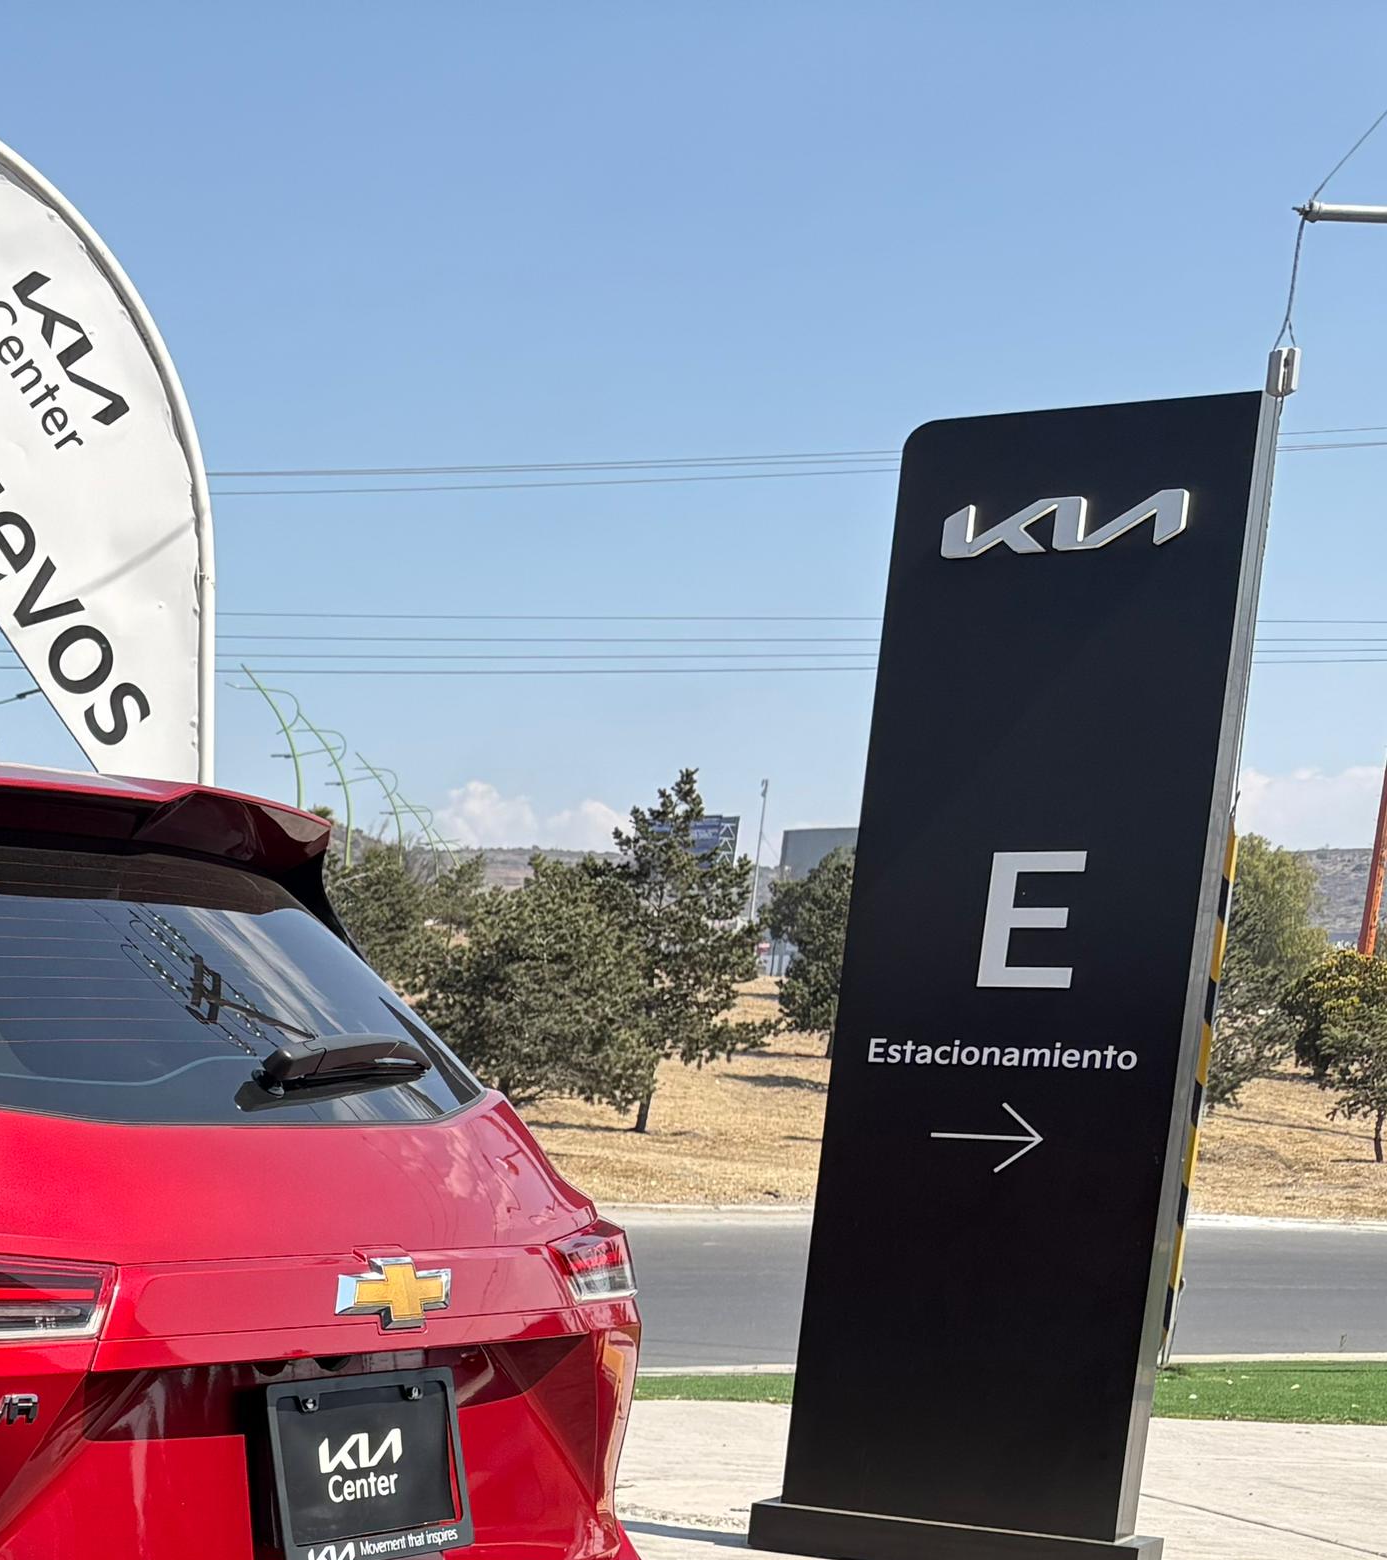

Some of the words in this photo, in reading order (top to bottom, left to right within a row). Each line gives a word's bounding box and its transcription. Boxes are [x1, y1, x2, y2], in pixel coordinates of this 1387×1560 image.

[12, 271, 130, 427] KIA
[940, 488, 1191, 559] KIA
[976, 850, 1088, 989] E
[867, 1038, 1138, 1072] Estacionamiento
[318, 1428, 403, 1474] KIA
[328, 1471, 398, 1503] Center
[360, 1535, 407, 1557] Movement
[407, 1531, 425, 1548] that
[426, 1527, 459, 1546] inspires
